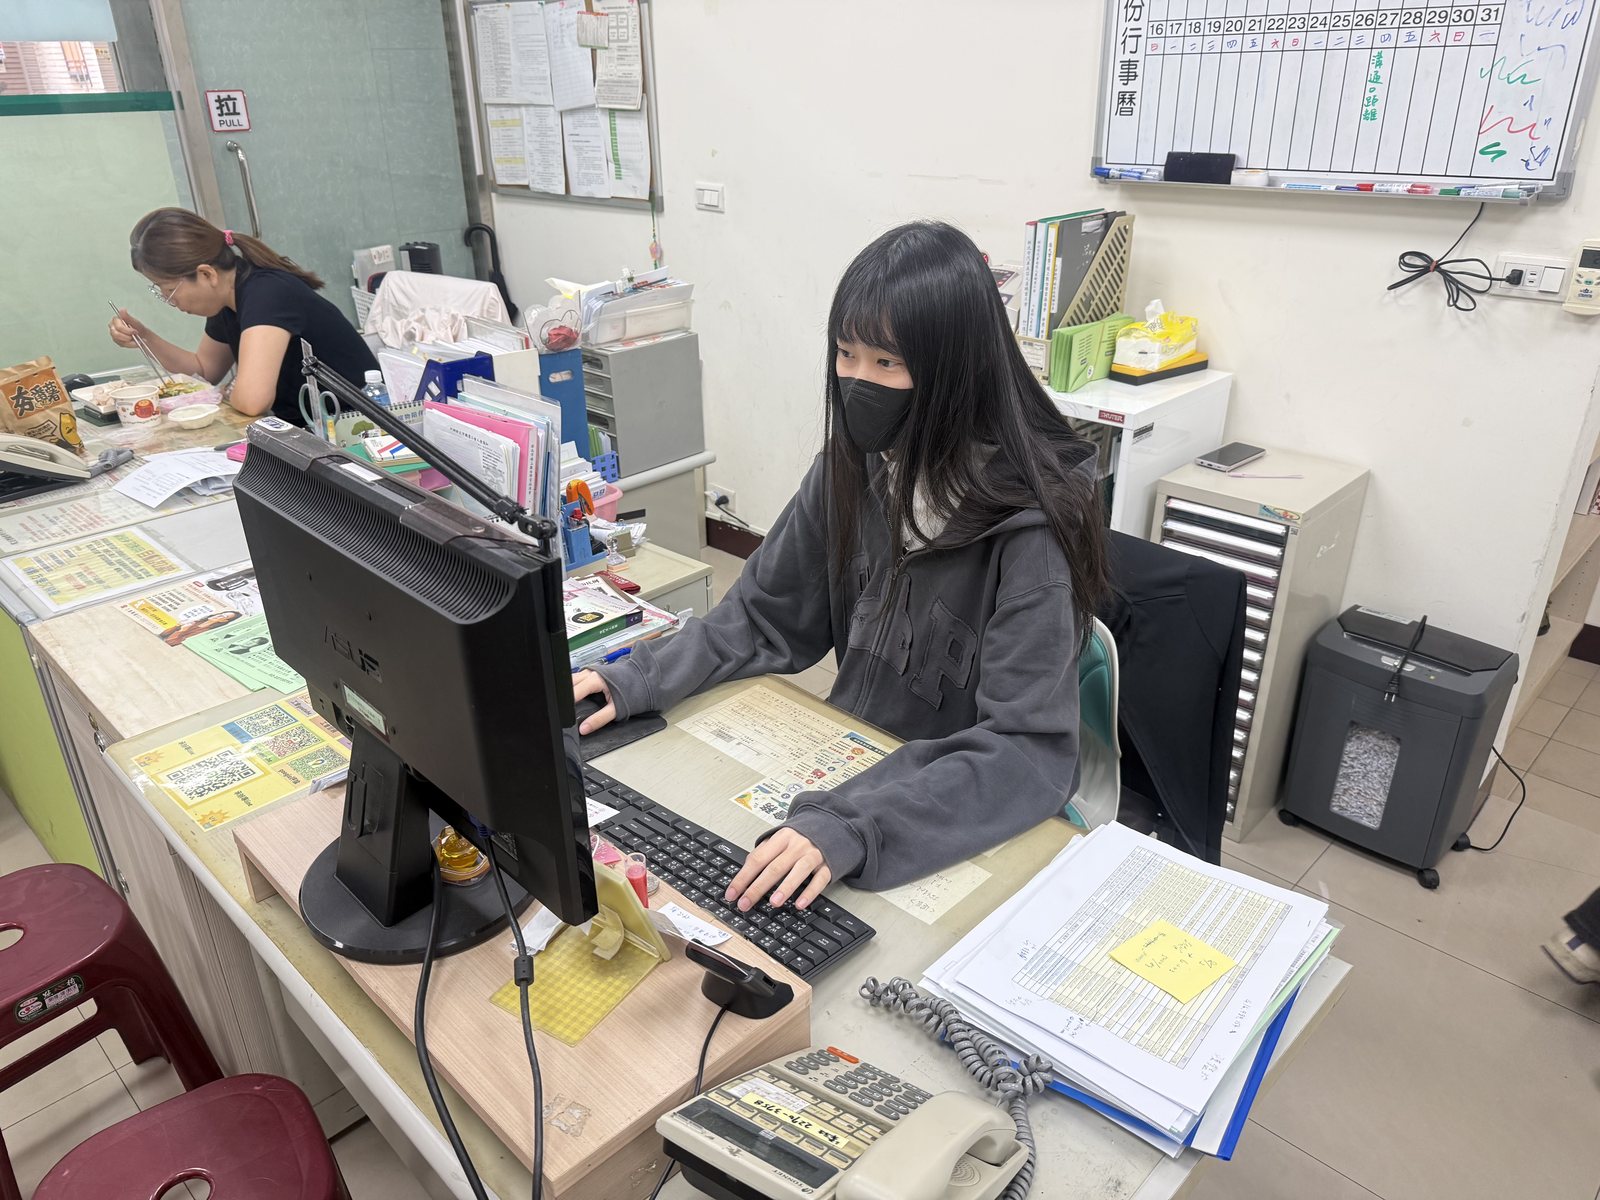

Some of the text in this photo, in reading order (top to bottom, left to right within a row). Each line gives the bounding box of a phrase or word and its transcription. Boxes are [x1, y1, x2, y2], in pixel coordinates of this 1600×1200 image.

[1150, 7, 1499, 35] 16 17 18 19 20 21 22 23 24 25 26 27 28 29 30 31
[215, 95, 240, 117] 拉
[219, 119, 243, 127] PULL
[10, 381, 61, 417] 夯番薯
